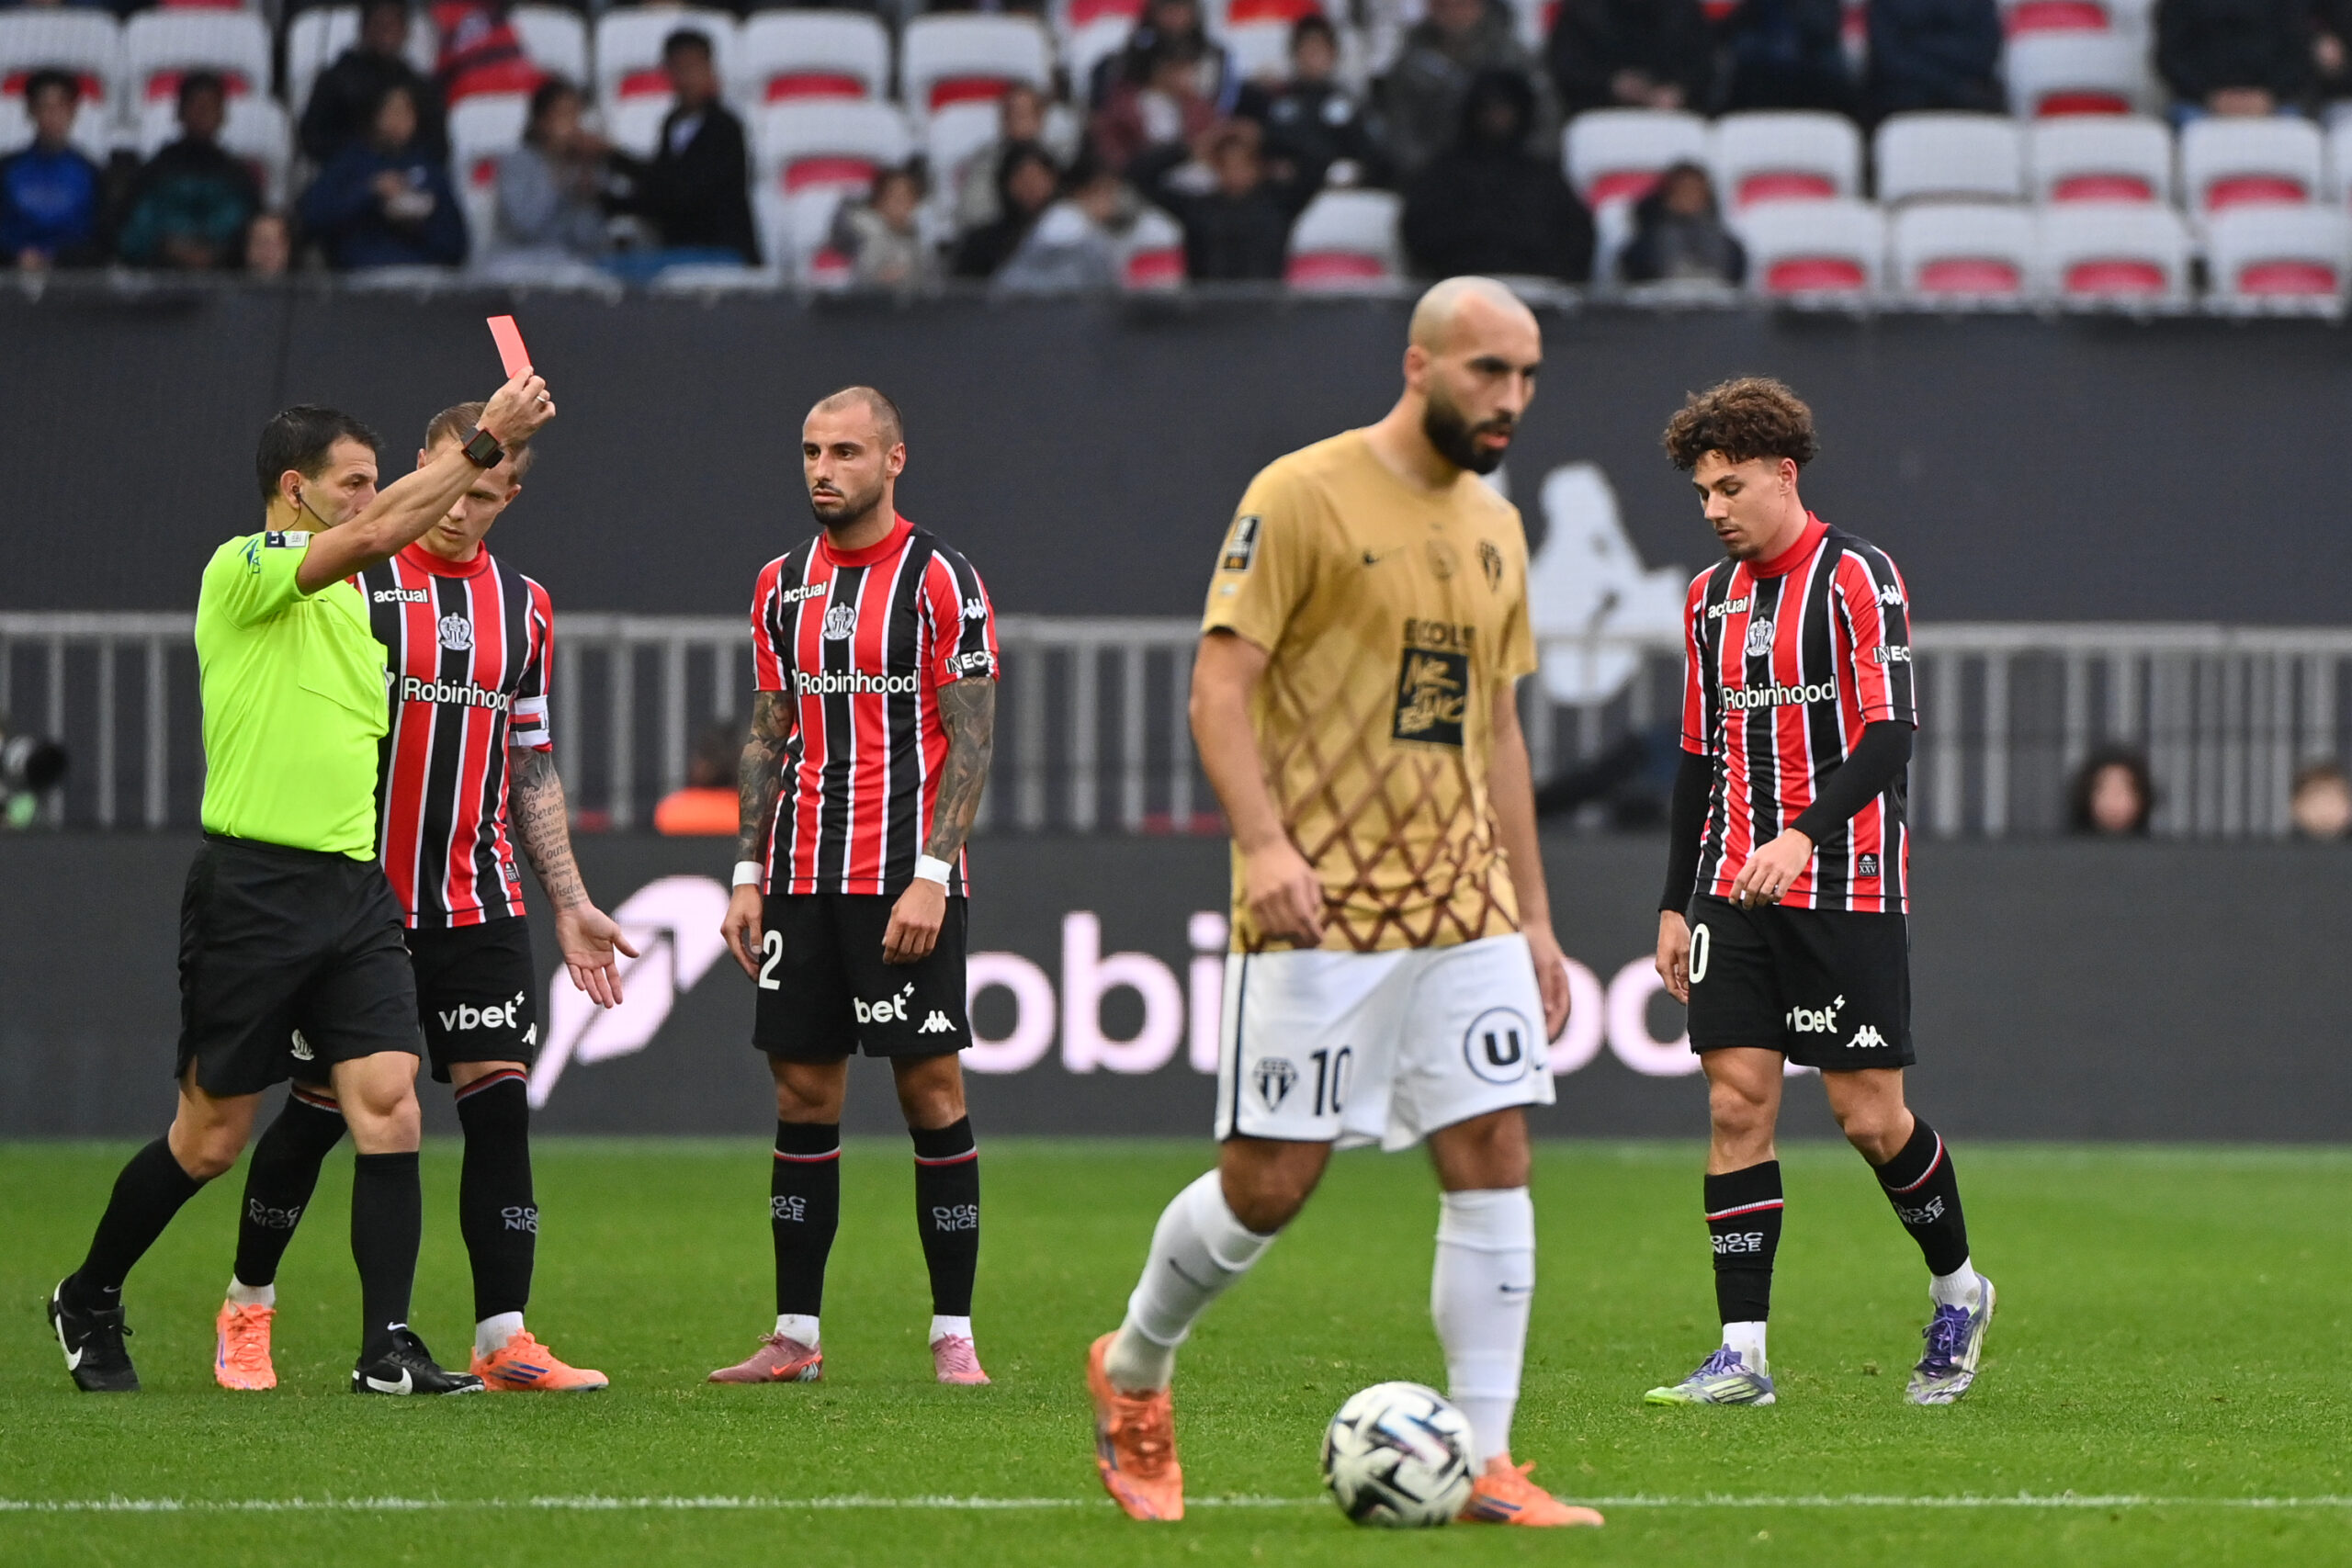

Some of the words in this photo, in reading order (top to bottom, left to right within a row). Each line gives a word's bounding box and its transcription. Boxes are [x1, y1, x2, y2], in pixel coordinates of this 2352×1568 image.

[373, 588, 429, 604] actual
[783, 581, 828, 603] actual
[1708, 596, 1748, 619] actual
[944, 650, 995, 674] INEOS
[1872, 645, 1911, 663] INEO
[798, 669, 918, 696] Robinhood
[1723, 676, 1837, 711] Robinhood
[758, 930, 783, 990] 2
[438, 1000, 518, 1032] vbet
[853, 993, 908, 1024] bet
[1485, 1029, 1521, 1066] U
[770, 1195, 807, 1209] GC
[501, 1206, 538, 1221] OG
[770, 1206, 805, 1222] ICE
[933, 1204, 978, 1219] OGC
[504, 1218, 538, 1233] NIC
[937, 1215, 978, 1231] NICE
[1709, 1232, 1764, 1245] OGC
[1713, 1241, 1761, 1254] NICE
